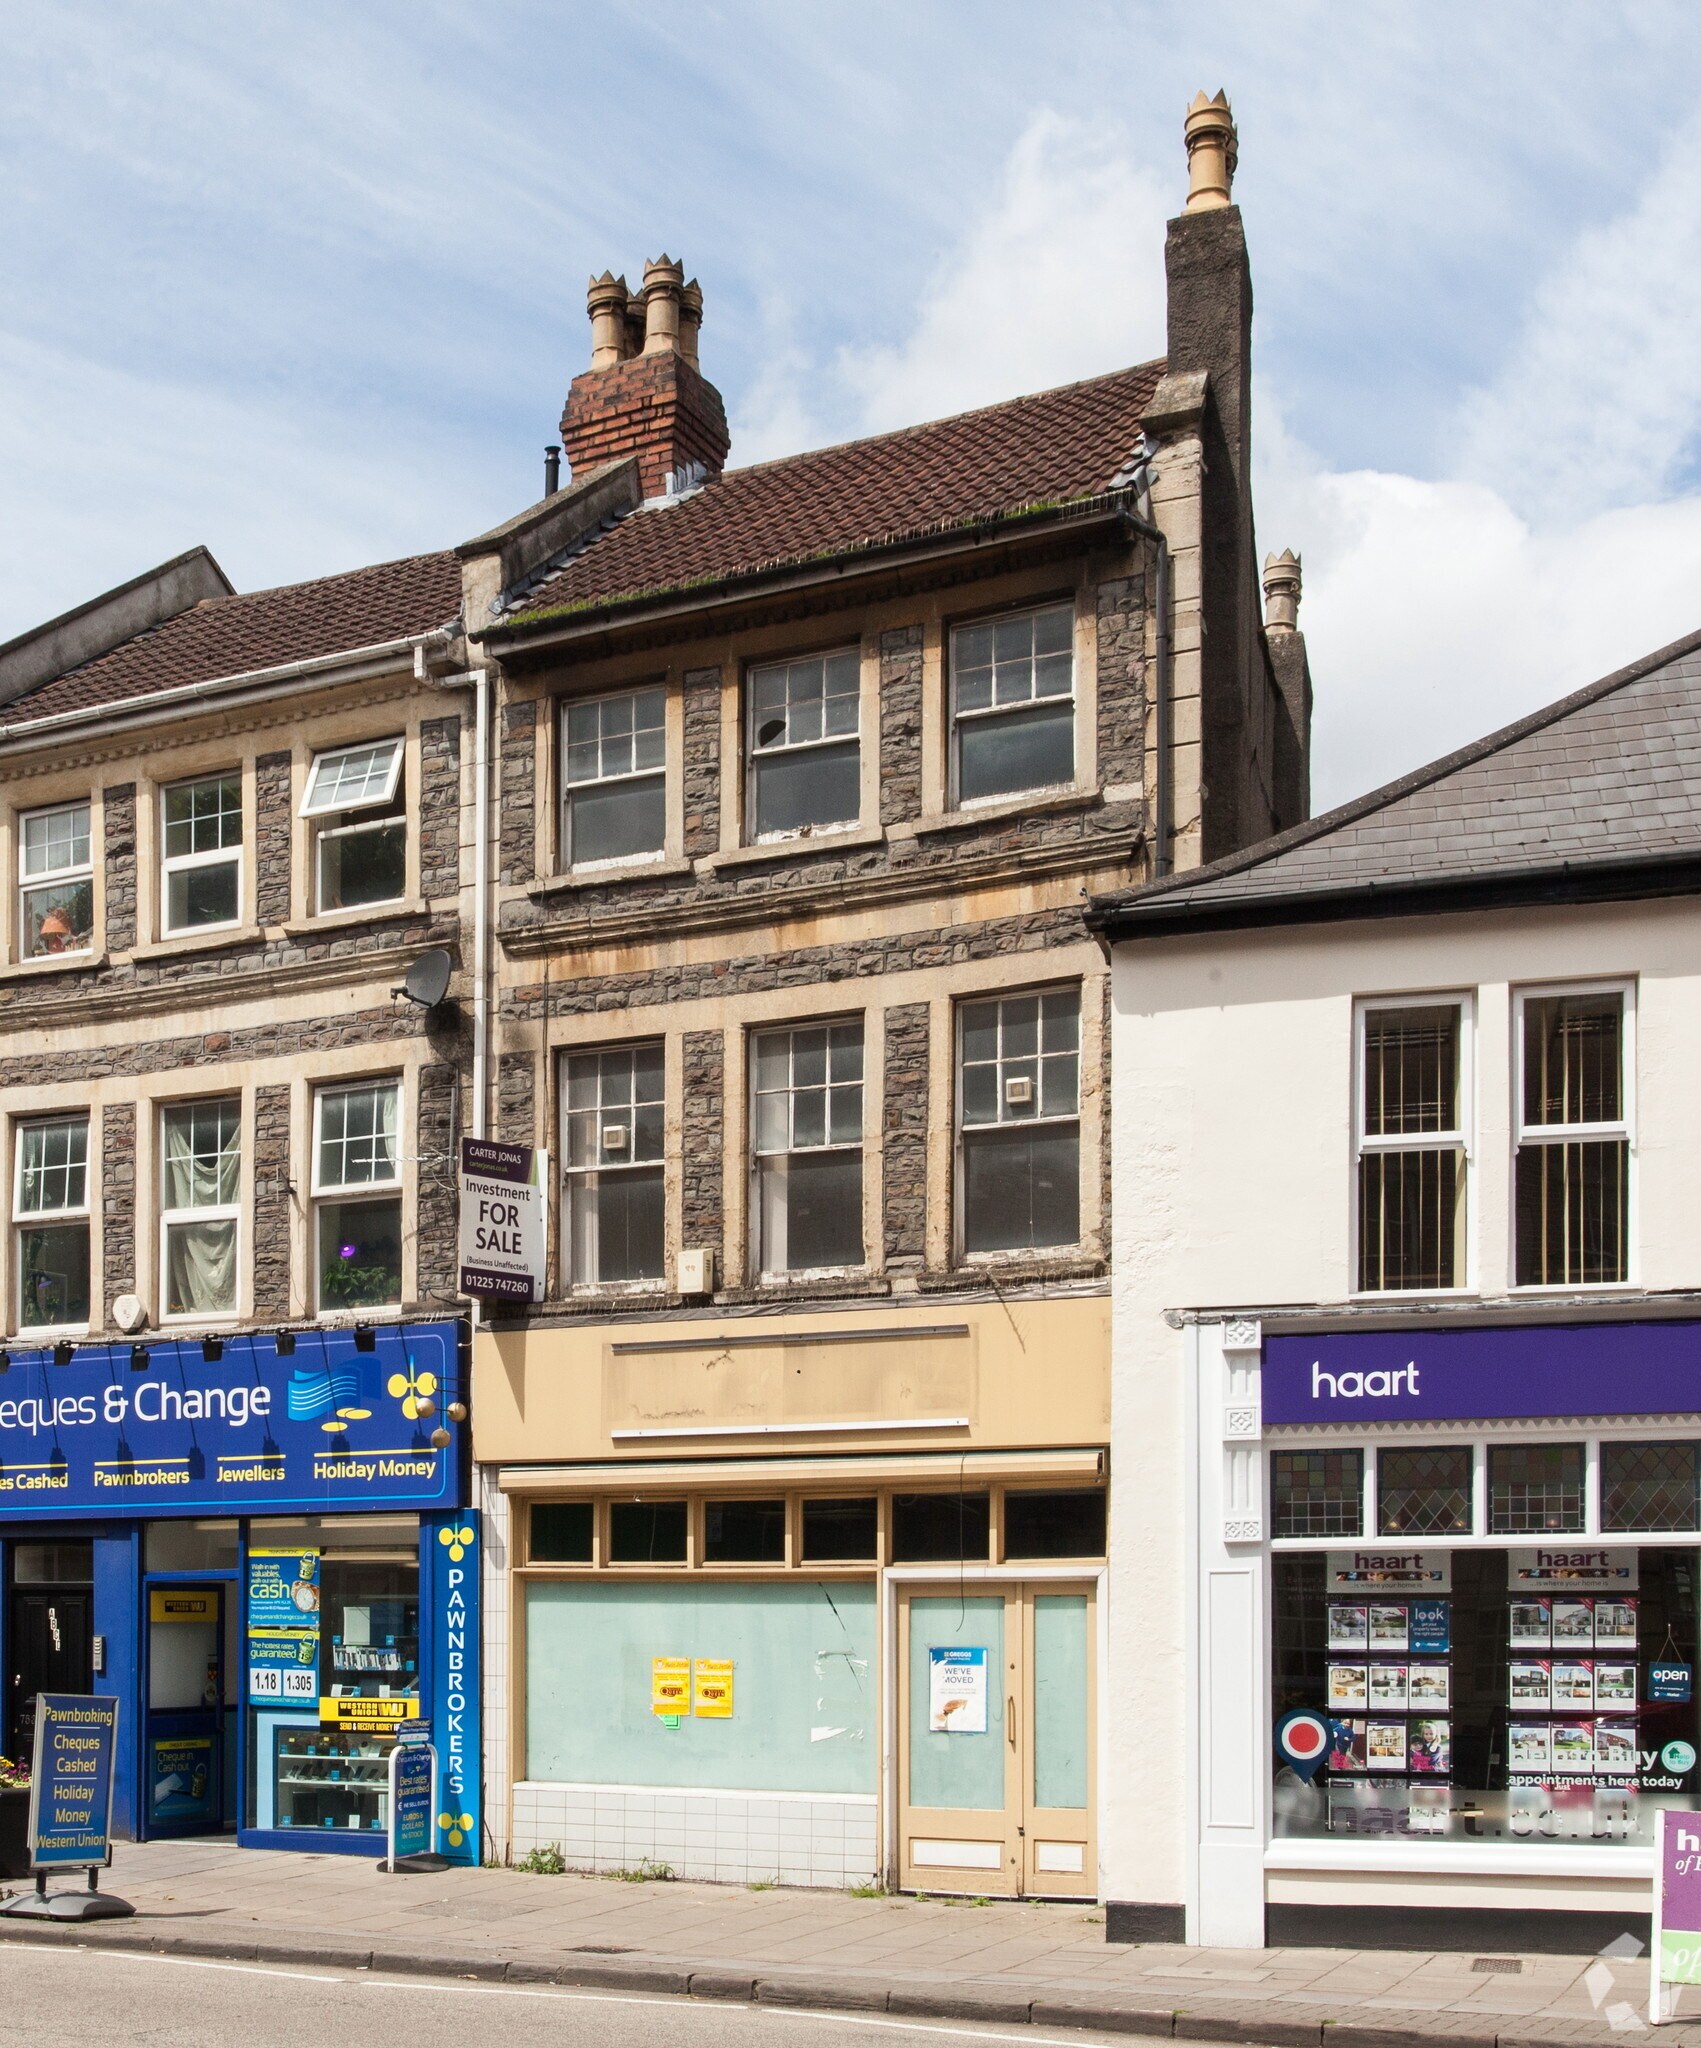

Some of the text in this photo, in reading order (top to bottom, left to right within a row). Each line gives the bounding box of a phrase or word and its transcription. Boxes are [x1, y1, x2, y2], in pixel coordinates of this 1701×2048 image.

[469, 1146, 522, 1164] CARTER JONAS
[466, 1178, 530, 1201] Investment
[479, 1200, 520, 1228] FOR
[475, 1227, 522, 1255] SALE
[466, 1255, 529, 1273] (Business Unaffected)
[466, 1274, 529, 1293] 01225 747260
[1312, 1361, 1420, 1398] haart
[0, 1381, 271, 1436] eques & Change
[94, 1468, 190, 1487] Pawnbrokers
[216, 1464, 286, 1483] Jewellers
[313, 1459, 437, 1481] Holiday Money
[16, 1472, 69, 1490] Cashed
[1355, 1553, 1423, 1569] haart
[1537, 1550, 1609, 1567] haart
[250, 1579, 290, 1599] cash
[1415, 1607, 1444, 1622] look
[250, 1649, 297, 1660] guaranteed
[944, 1667, 971, 1675] WE'VE
[1653, 1669, 1689, 1683] open
[255, 1672, 277, 1690] 1.18
[286, 1675, 312, 1691] 1.305
[446, 1568, 466, 1795] PAWNBROKERS
[44, 1706, 113, 1726] Pawnbroking
[378, 1702, 404, 1717] WU
[340, 1722, 352, 1731] SEND
[357, 1722, 375, 1731] RECEIVE
[376, 1722, 393, 1731] MONEY
[54, 1734, 100, 1753] Cheques
[56, 1757, 97, 1772] Cashed
[157, 1751, 186, 1762] Cheque
[157, 1762, 177, 1773] Cash
[1508, 1774, 1683, 1790] appointments here today
[54, 1784, 94, 1803] Holiday
[55, 1808, 91, 1826] Money
[36, 1832, 105, 1849] Western Union
[1675, 1854, 1696, 1876] of
